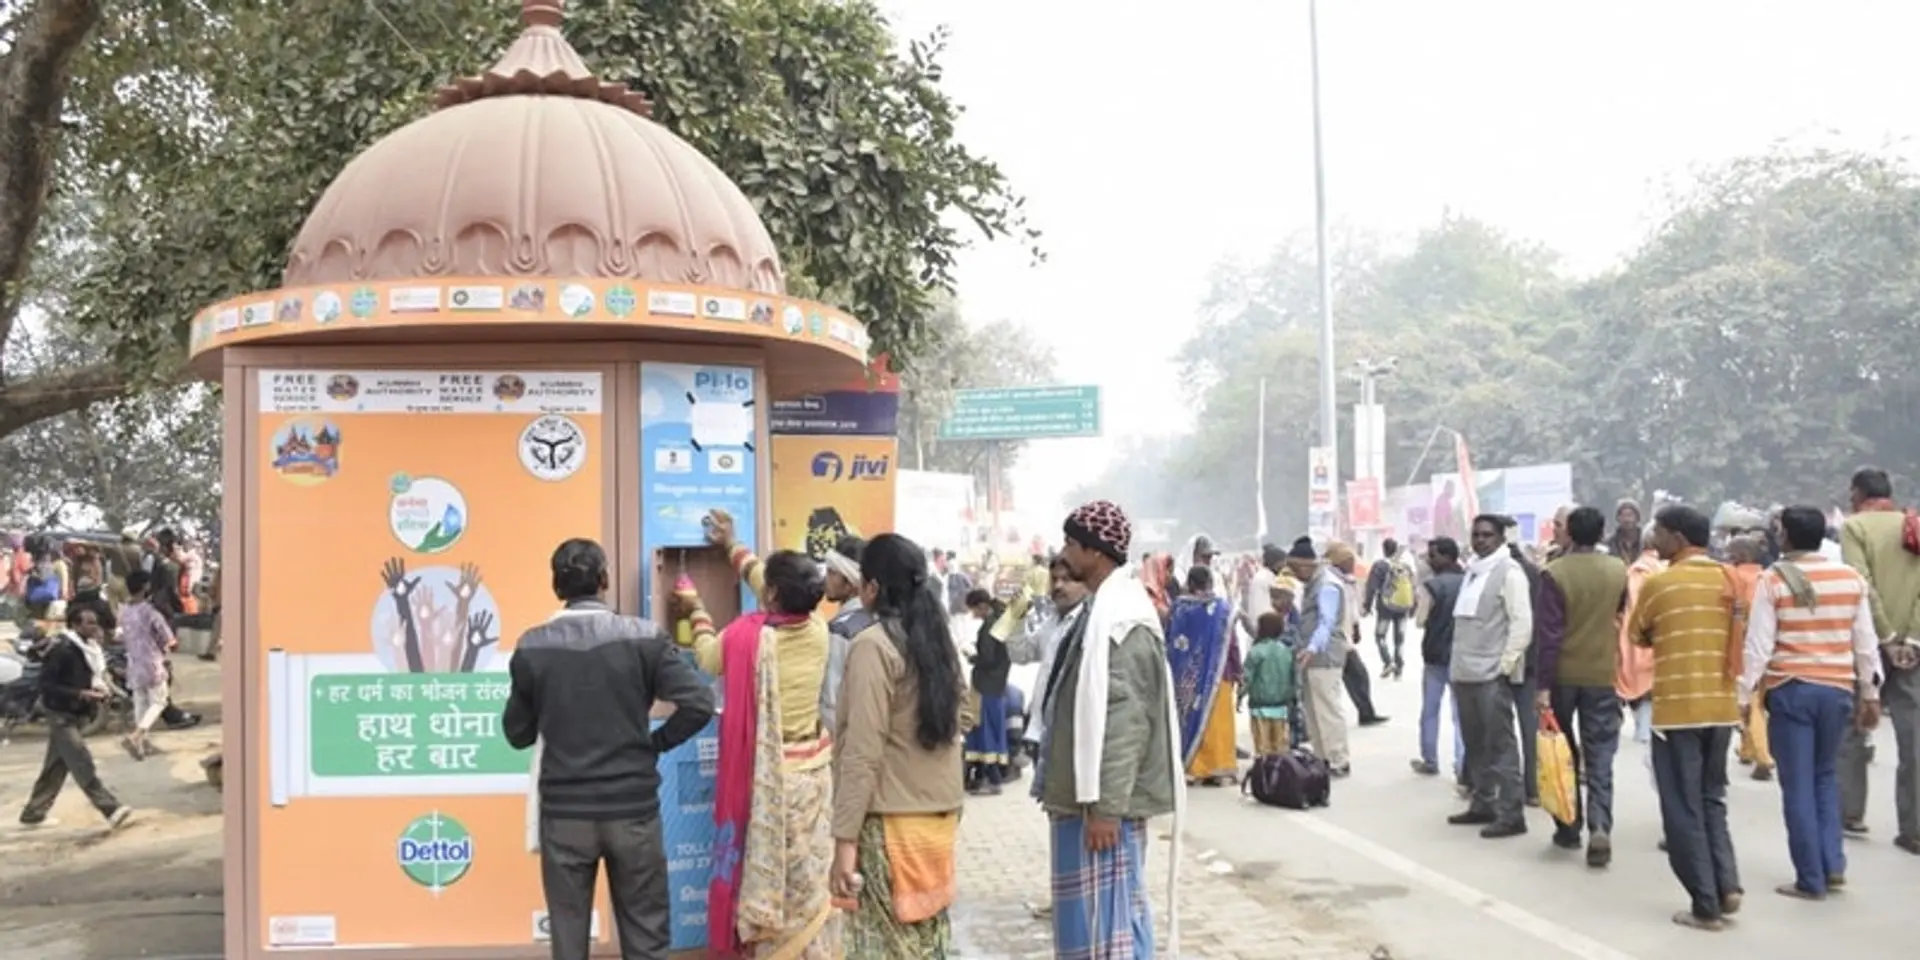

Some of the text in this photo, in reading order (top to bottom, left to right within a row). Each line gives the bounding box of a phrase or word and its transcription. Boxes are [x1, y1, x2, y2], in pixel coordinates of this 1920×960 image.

[273, 374, 316, 385] FREE
[439, 374, 484, 385] FREE
[847, 454, 889, 481] jivi
[328, 684, 352, 704] हर
[358, 677, 384, 702] धर्म
[390, 684, 414, 701] का
[420, 677, 469, 702] भोजन
[356, 702, 500, 741] हाथ धोना
[376, 743, 481, 772] हर बार
[401, 839, 469, 861] Dettol
